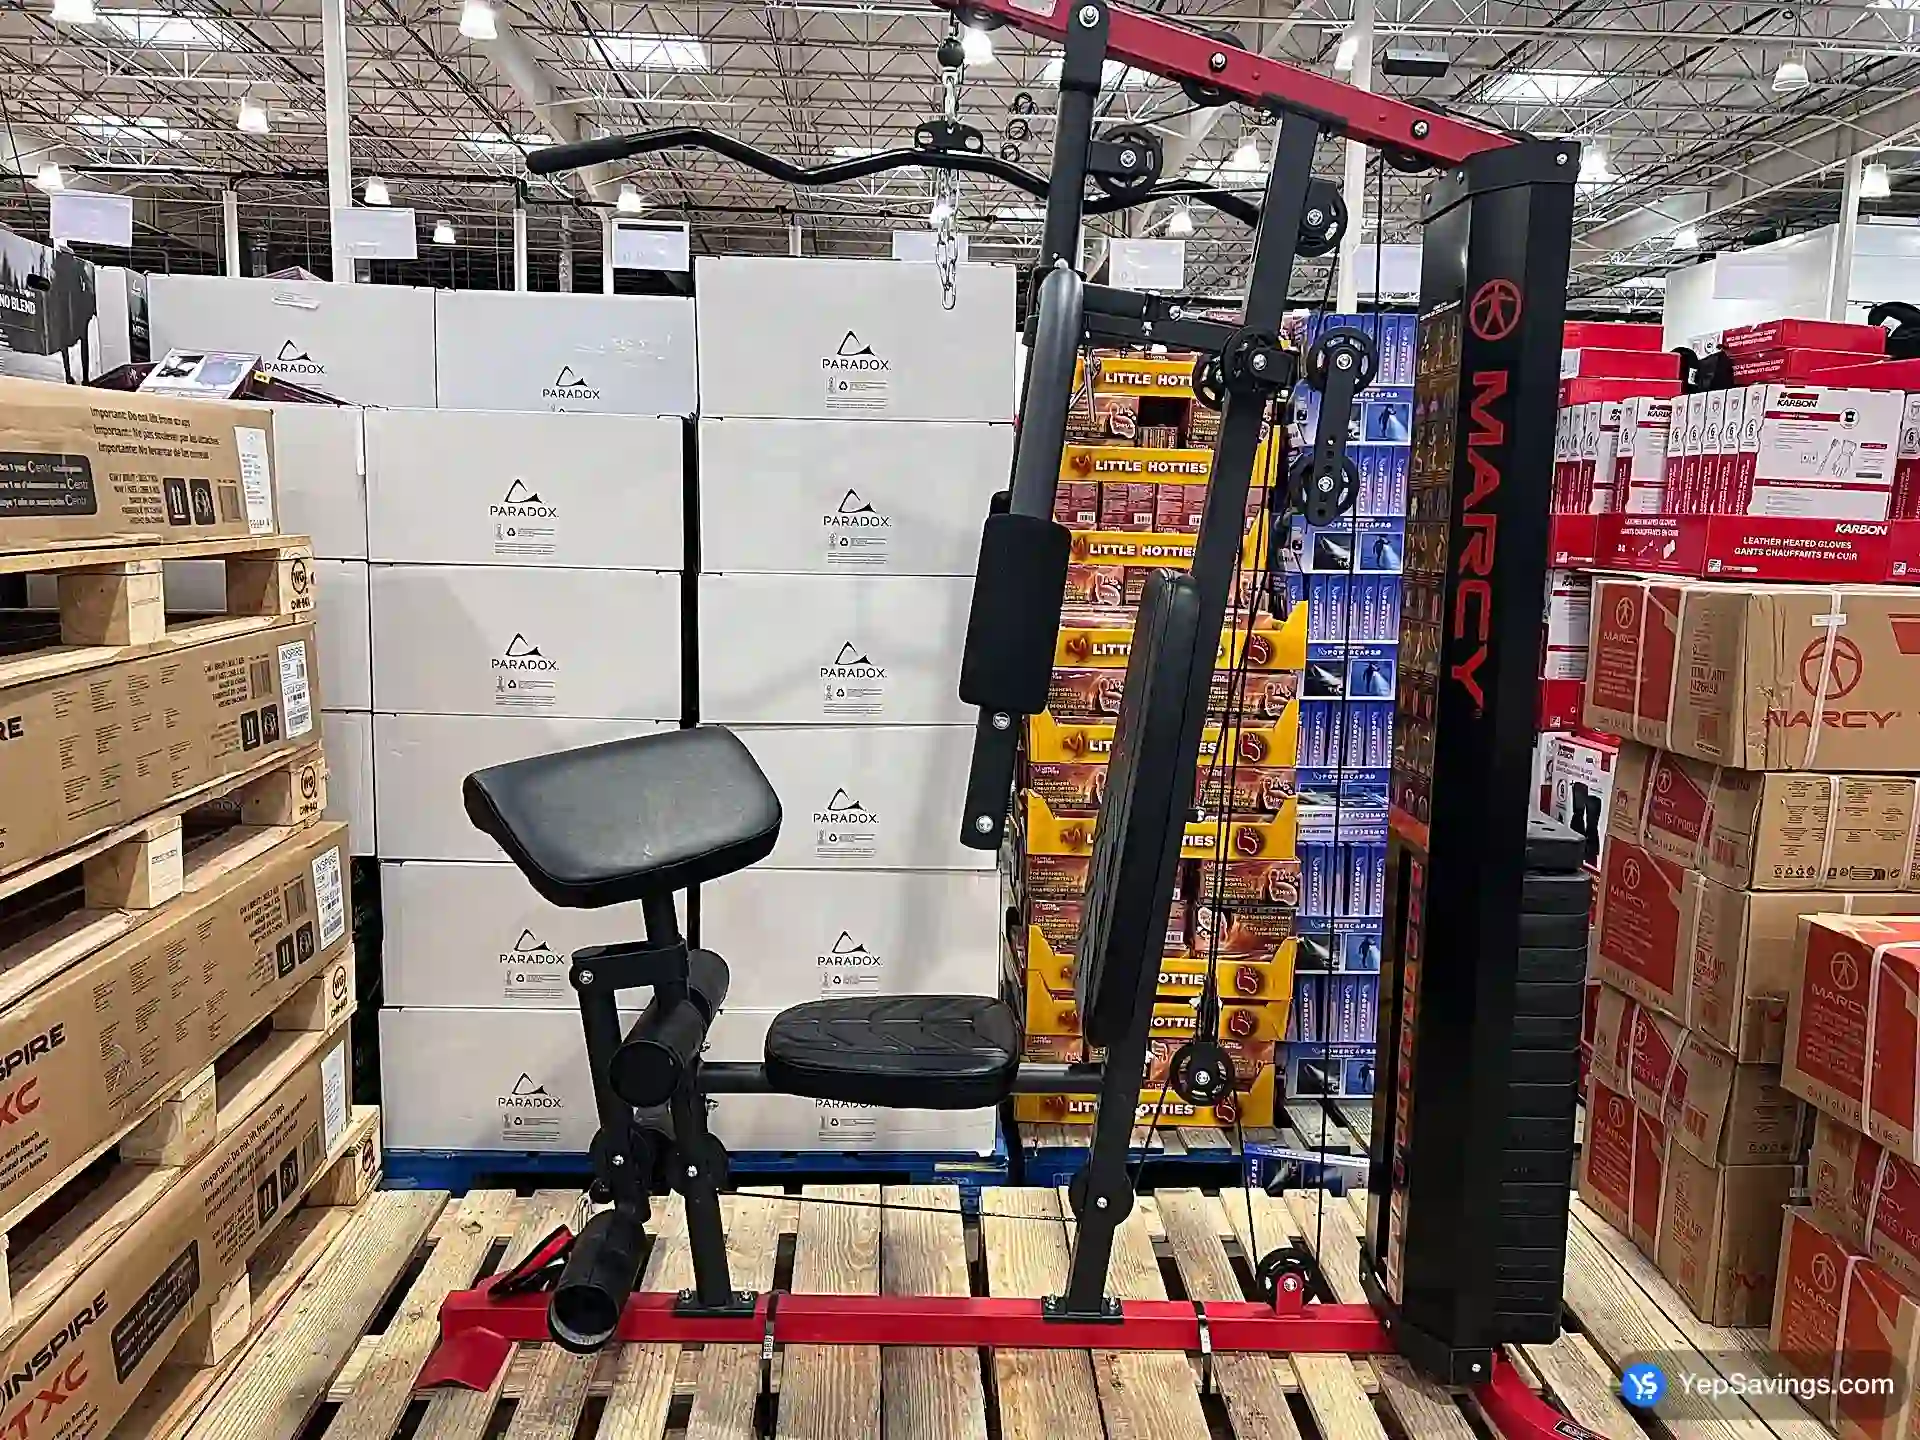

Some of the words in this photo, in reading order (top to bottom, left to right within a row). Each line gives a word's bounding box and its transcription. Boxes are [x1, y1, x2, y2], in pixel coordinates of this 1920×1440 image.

[264, 362, 325, 374] PARADOX
[822, 359, 892, 371] PARADOX
[1105, 373, 1151, 385] LITTLE
[542, 388, 600, 400] PARADOX
[1777, 399, 1818, 408] KARBON
[1095, 460, 1142, 472] LITTLE
[1148, 462, 1208, 474] HOTTIES
[490, 505, 560, 518] PARADOX
[823, 516, 892, 528] PARADOX
[1835, 523, 1888, 536] KARBON
[1451, 370, 1508, 711] MARCY
[1743, 536, 1782, 547] LEATHER
[1783, 538, 1816, 548] HEATED
[1818, 539, 1852, 549] GLOVES
[1089, 543, 1136, 555] LITTLE
[1734, 547, 1763, 557] GANTS
[1764, 547, 1821, 560] CHAUFFANTS
[1823, 549, 1835, 560] EN
[1836, 550, 1859, 561] CUIR
[491, 659, 560, 671] PARADOX
[820, 667, 888, 678] PARADOX
[1766, 710, 1897, 729] MARCY
[813, 813, 880, 824] PARADOX
[499, 954, 564, 965] PARADOX
[817, 956, 883, 966] PARADOX
[498, 1098, 563, 1108] PARADOX
[239, 1138, 251, 1155] not
[255, 1120, 271, 1140] from
[3, 1289, 109, 1402] INSPIRE
